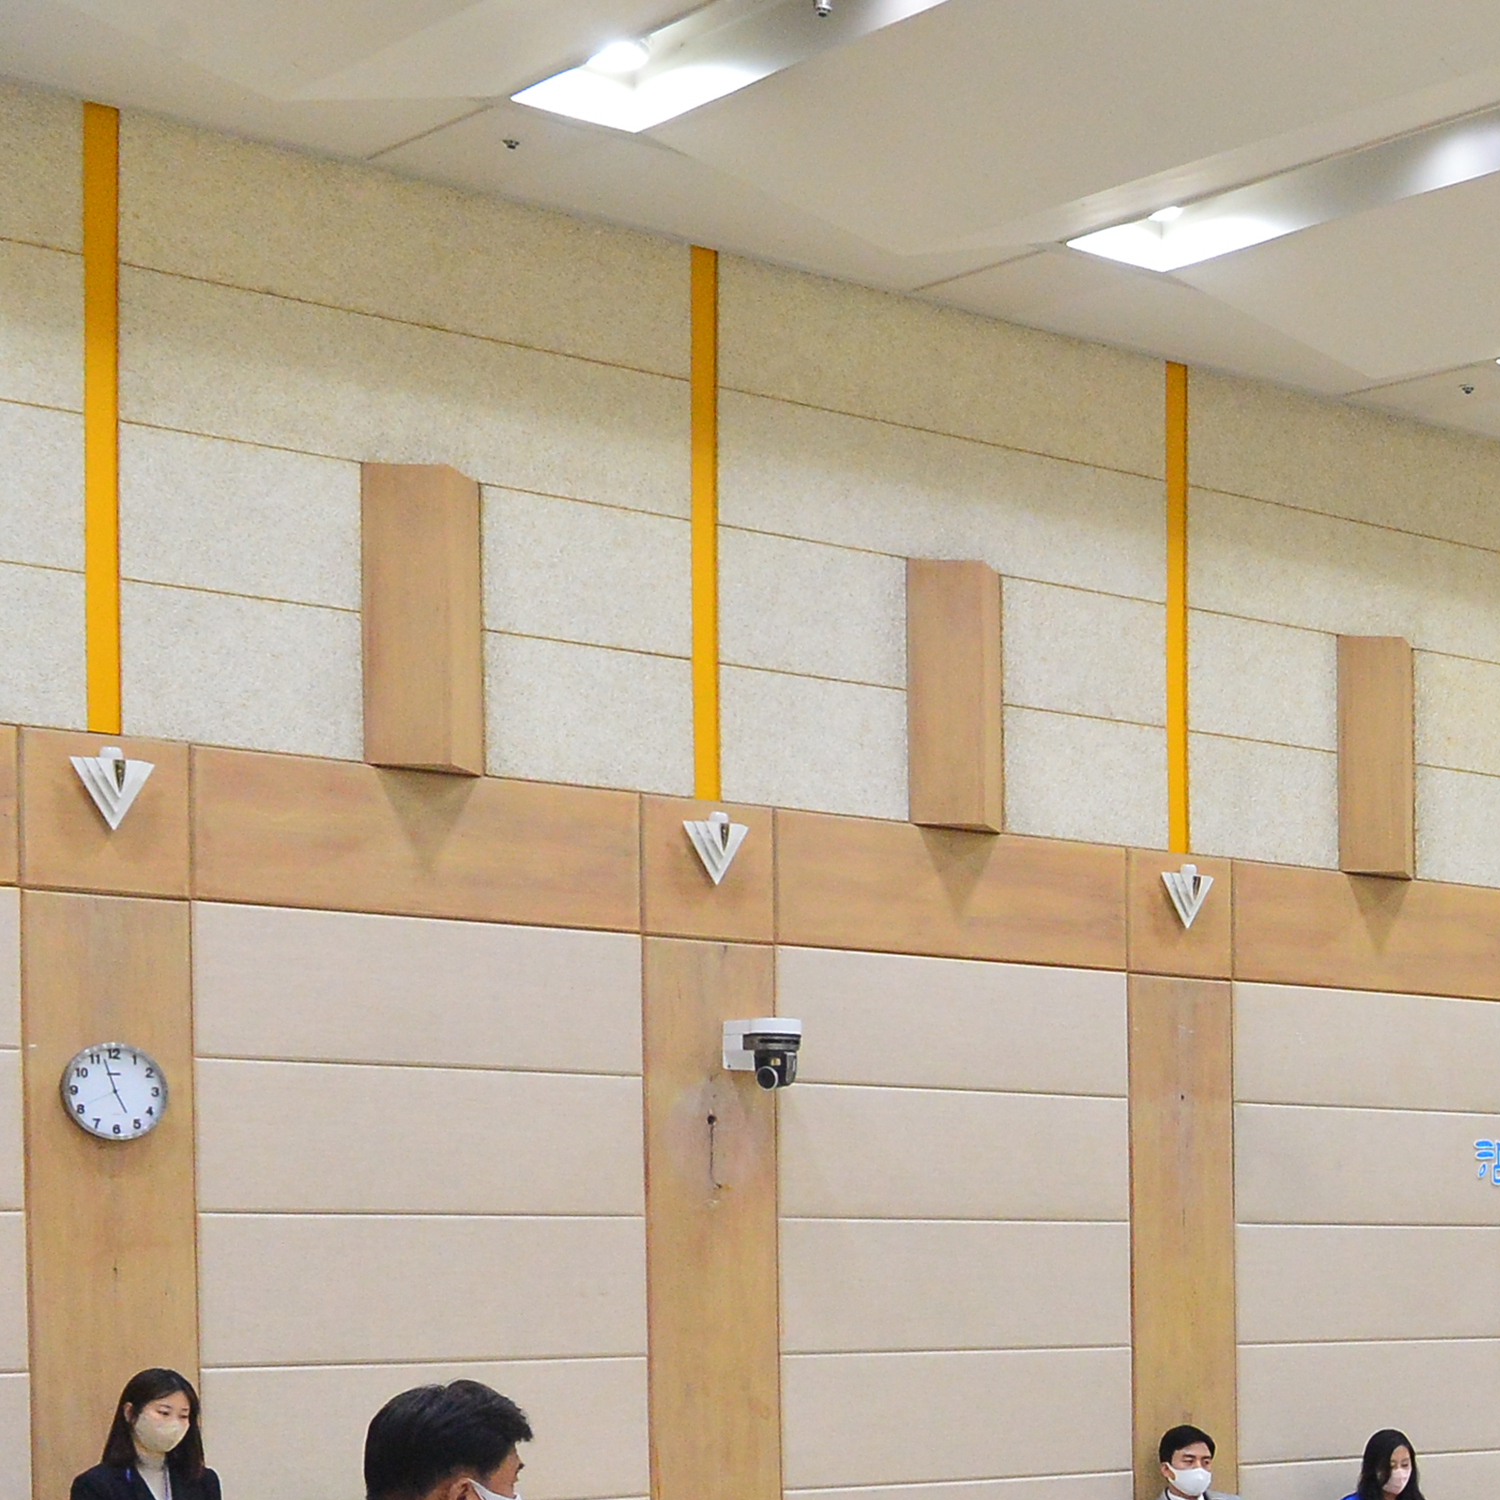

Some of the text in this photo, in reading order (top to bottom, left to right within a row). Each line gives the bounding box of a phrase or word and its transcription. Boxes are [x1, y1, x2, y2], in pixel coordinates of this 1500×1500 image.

[108, 1048, 121, 1059] 12
[90, 1054, 101, 1064] 11
[132, 1055, 137, 1065] 1
[76, 1068, 88, 1078] 10
[146, 1068, 154, 1078] 2
[69, 1085, 78, 1095] 9
[151, 1087, 160, 1097] 3
[77, 1104, 85, 1114] 8
[146, 1106, 153, 1116] 4
[92, 1118, 101, 1129] 7
[133, 1119, 141, 1129] 5
[113, 1124, 121, 1134] 6
